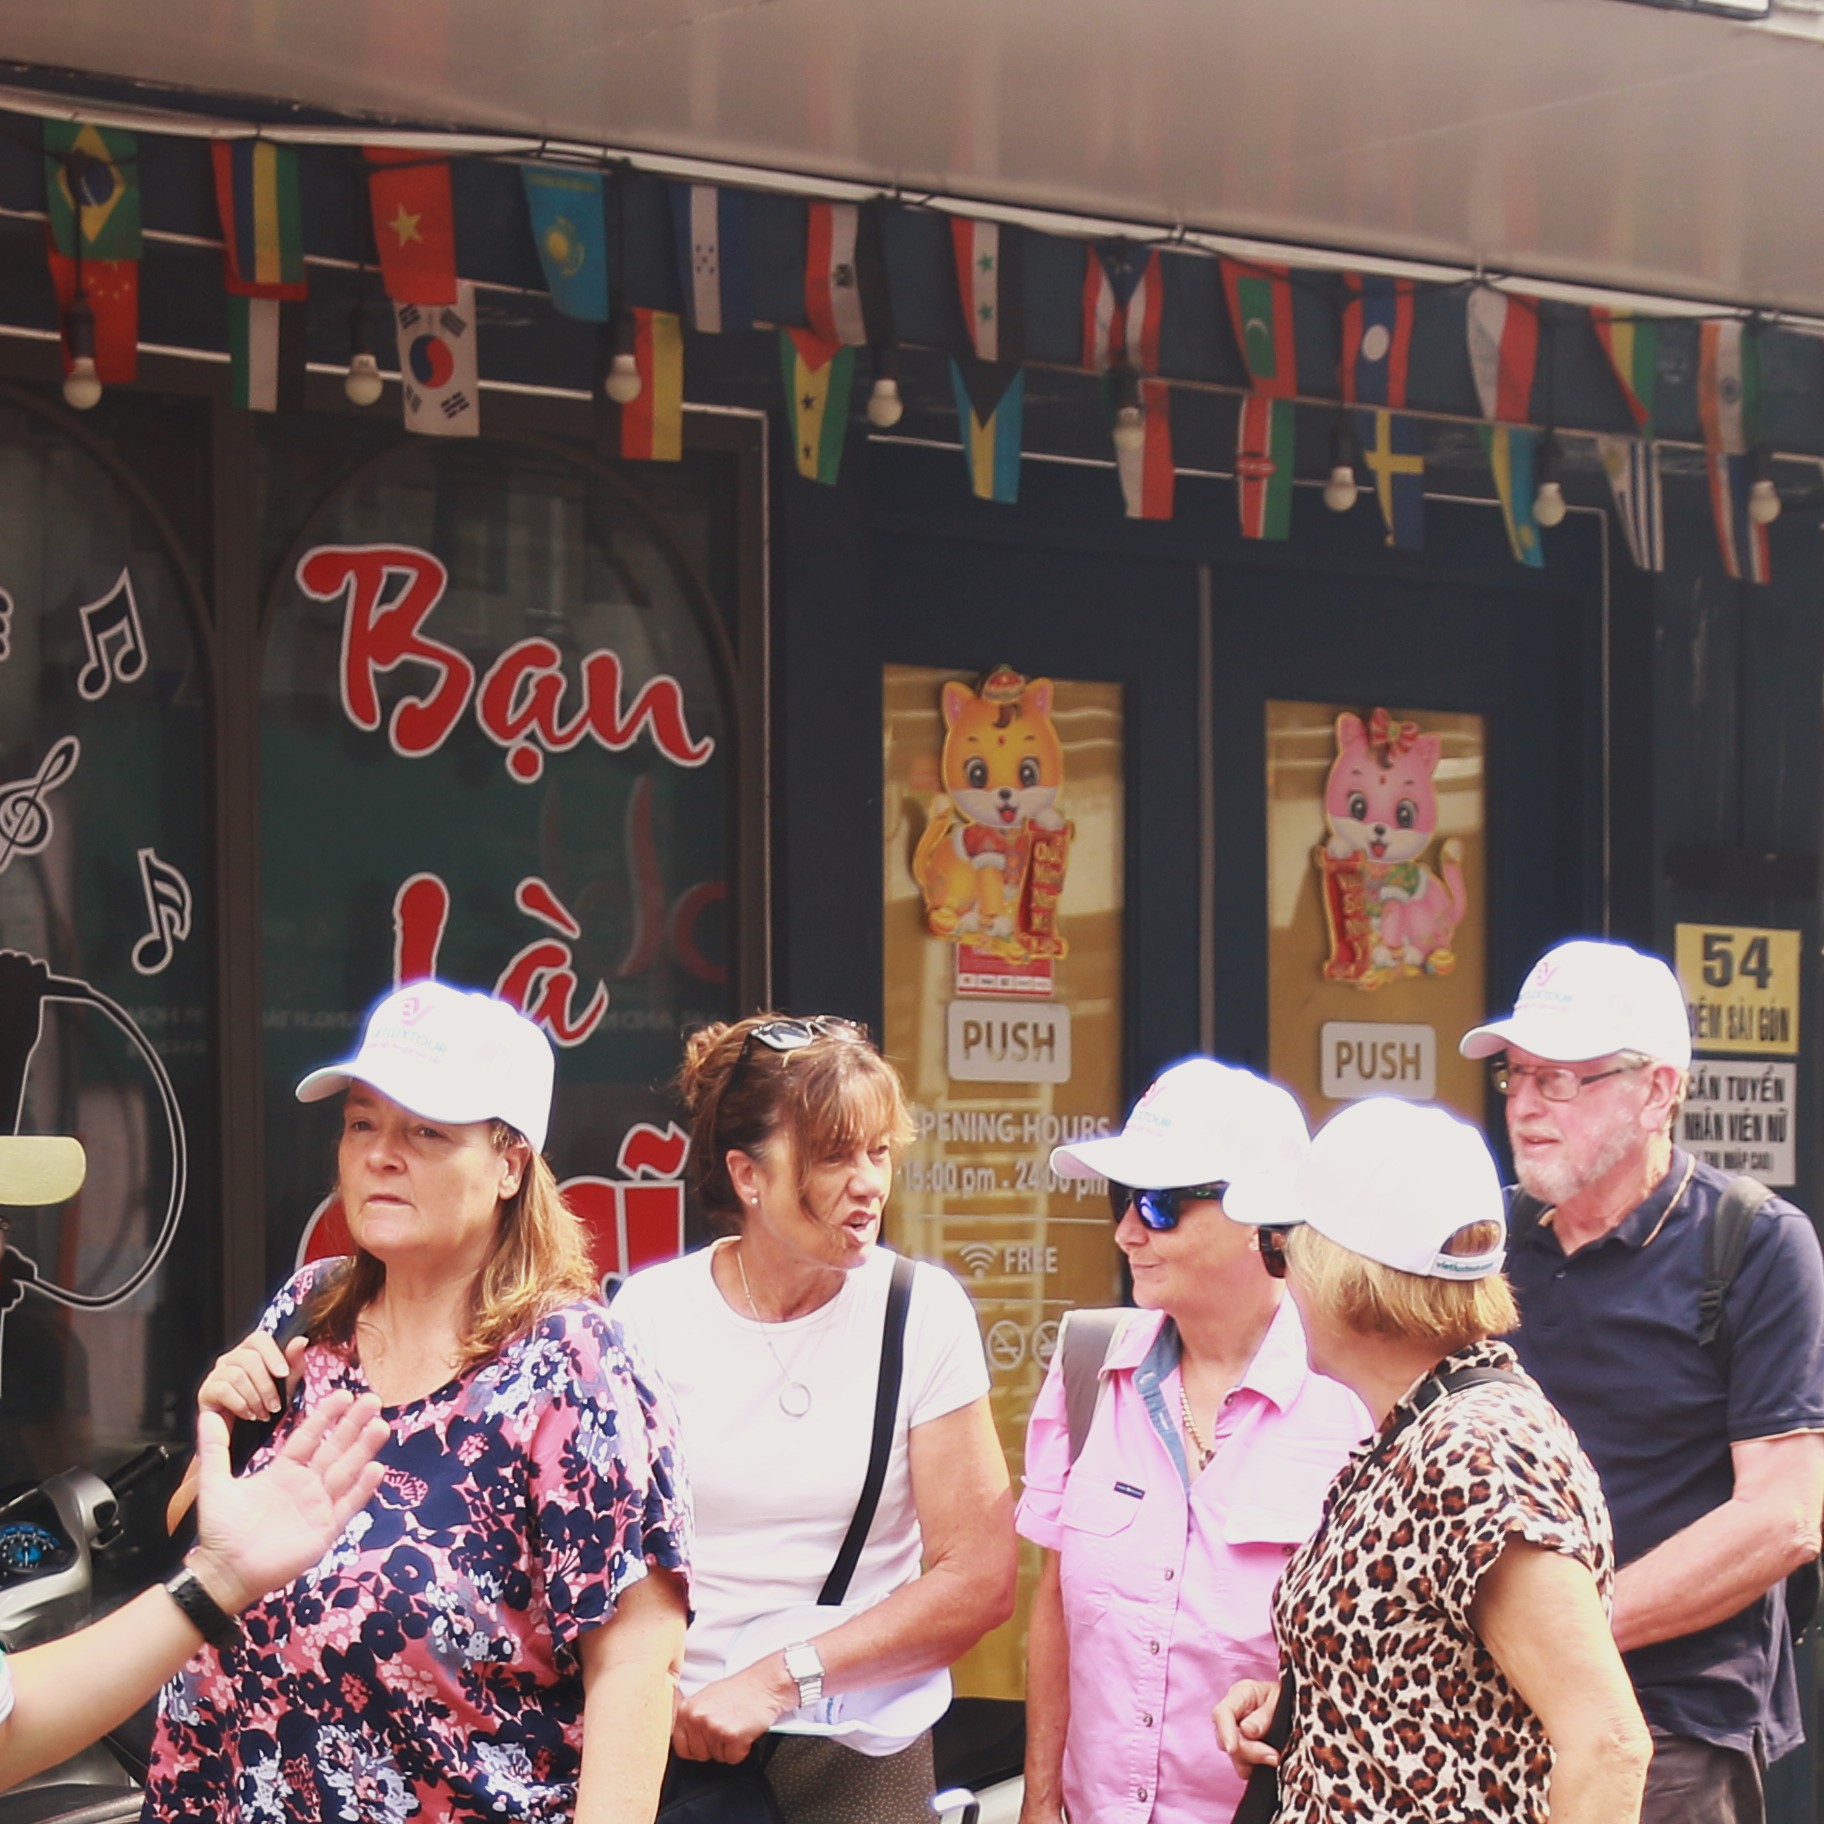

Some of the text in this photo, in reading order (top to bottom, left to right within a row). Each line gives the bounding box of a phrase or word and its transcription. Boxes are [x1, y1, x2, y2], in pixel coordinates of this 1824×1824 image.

[297, 543, 715, 784] Bạn
[1702, 933, 1773, 989] 54
[963, 1019, 1056, 1063] PUSH
[1334, 1040, 1422, 1083] PUSH
[916, 1110, 1016, 1143] PENING
[1022, 1114, 1110, 1143] HOURS
[962, 1167, 995, 1200] pm
[1003, 1247, 1058, 1274] FREE
